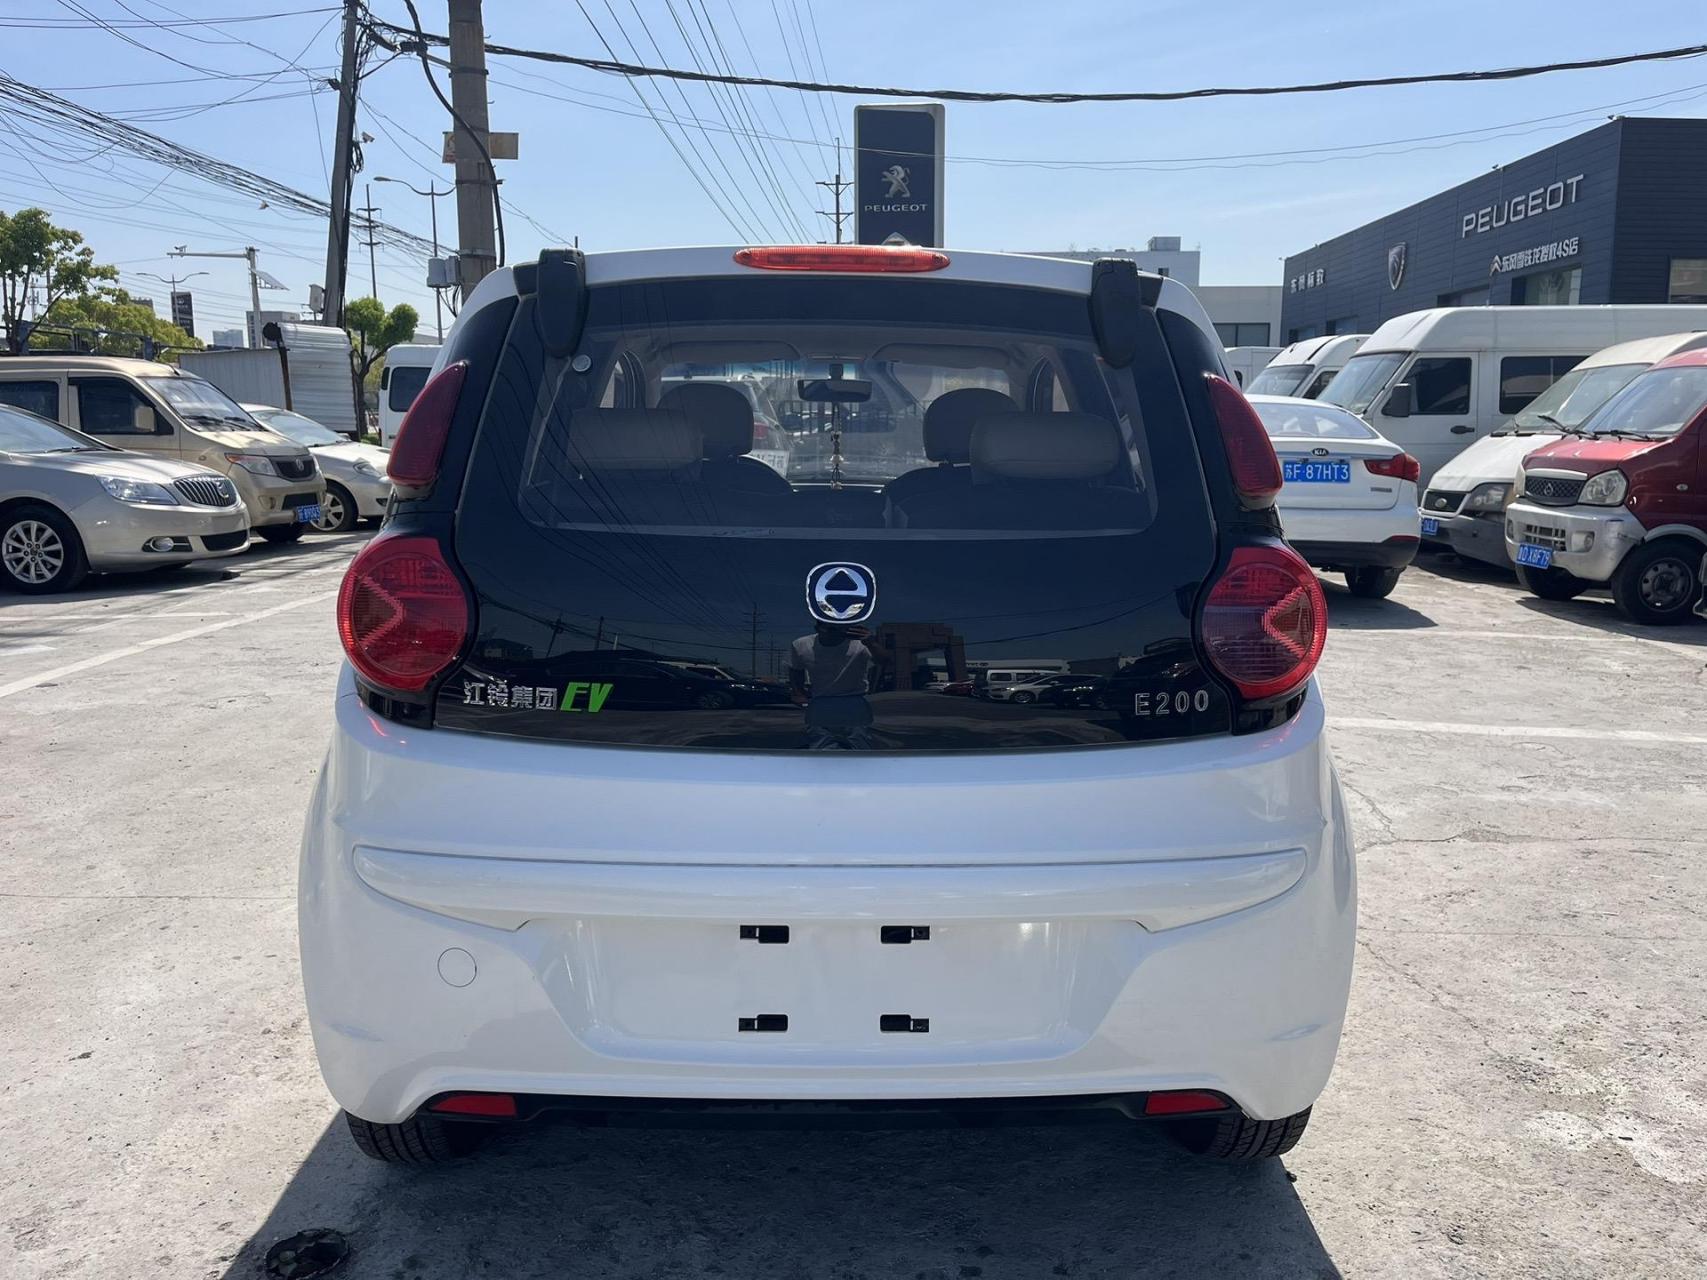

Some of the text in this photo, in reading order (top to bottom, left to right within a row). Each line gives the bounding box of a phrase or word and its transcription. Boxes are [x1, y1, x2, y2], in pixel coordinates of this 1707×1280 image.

[864, 203, 928, 212] PEUGEOT
[1462, 174, 1584, 238] PEUGEOT
[1135, 690, 1209, 715] E200
